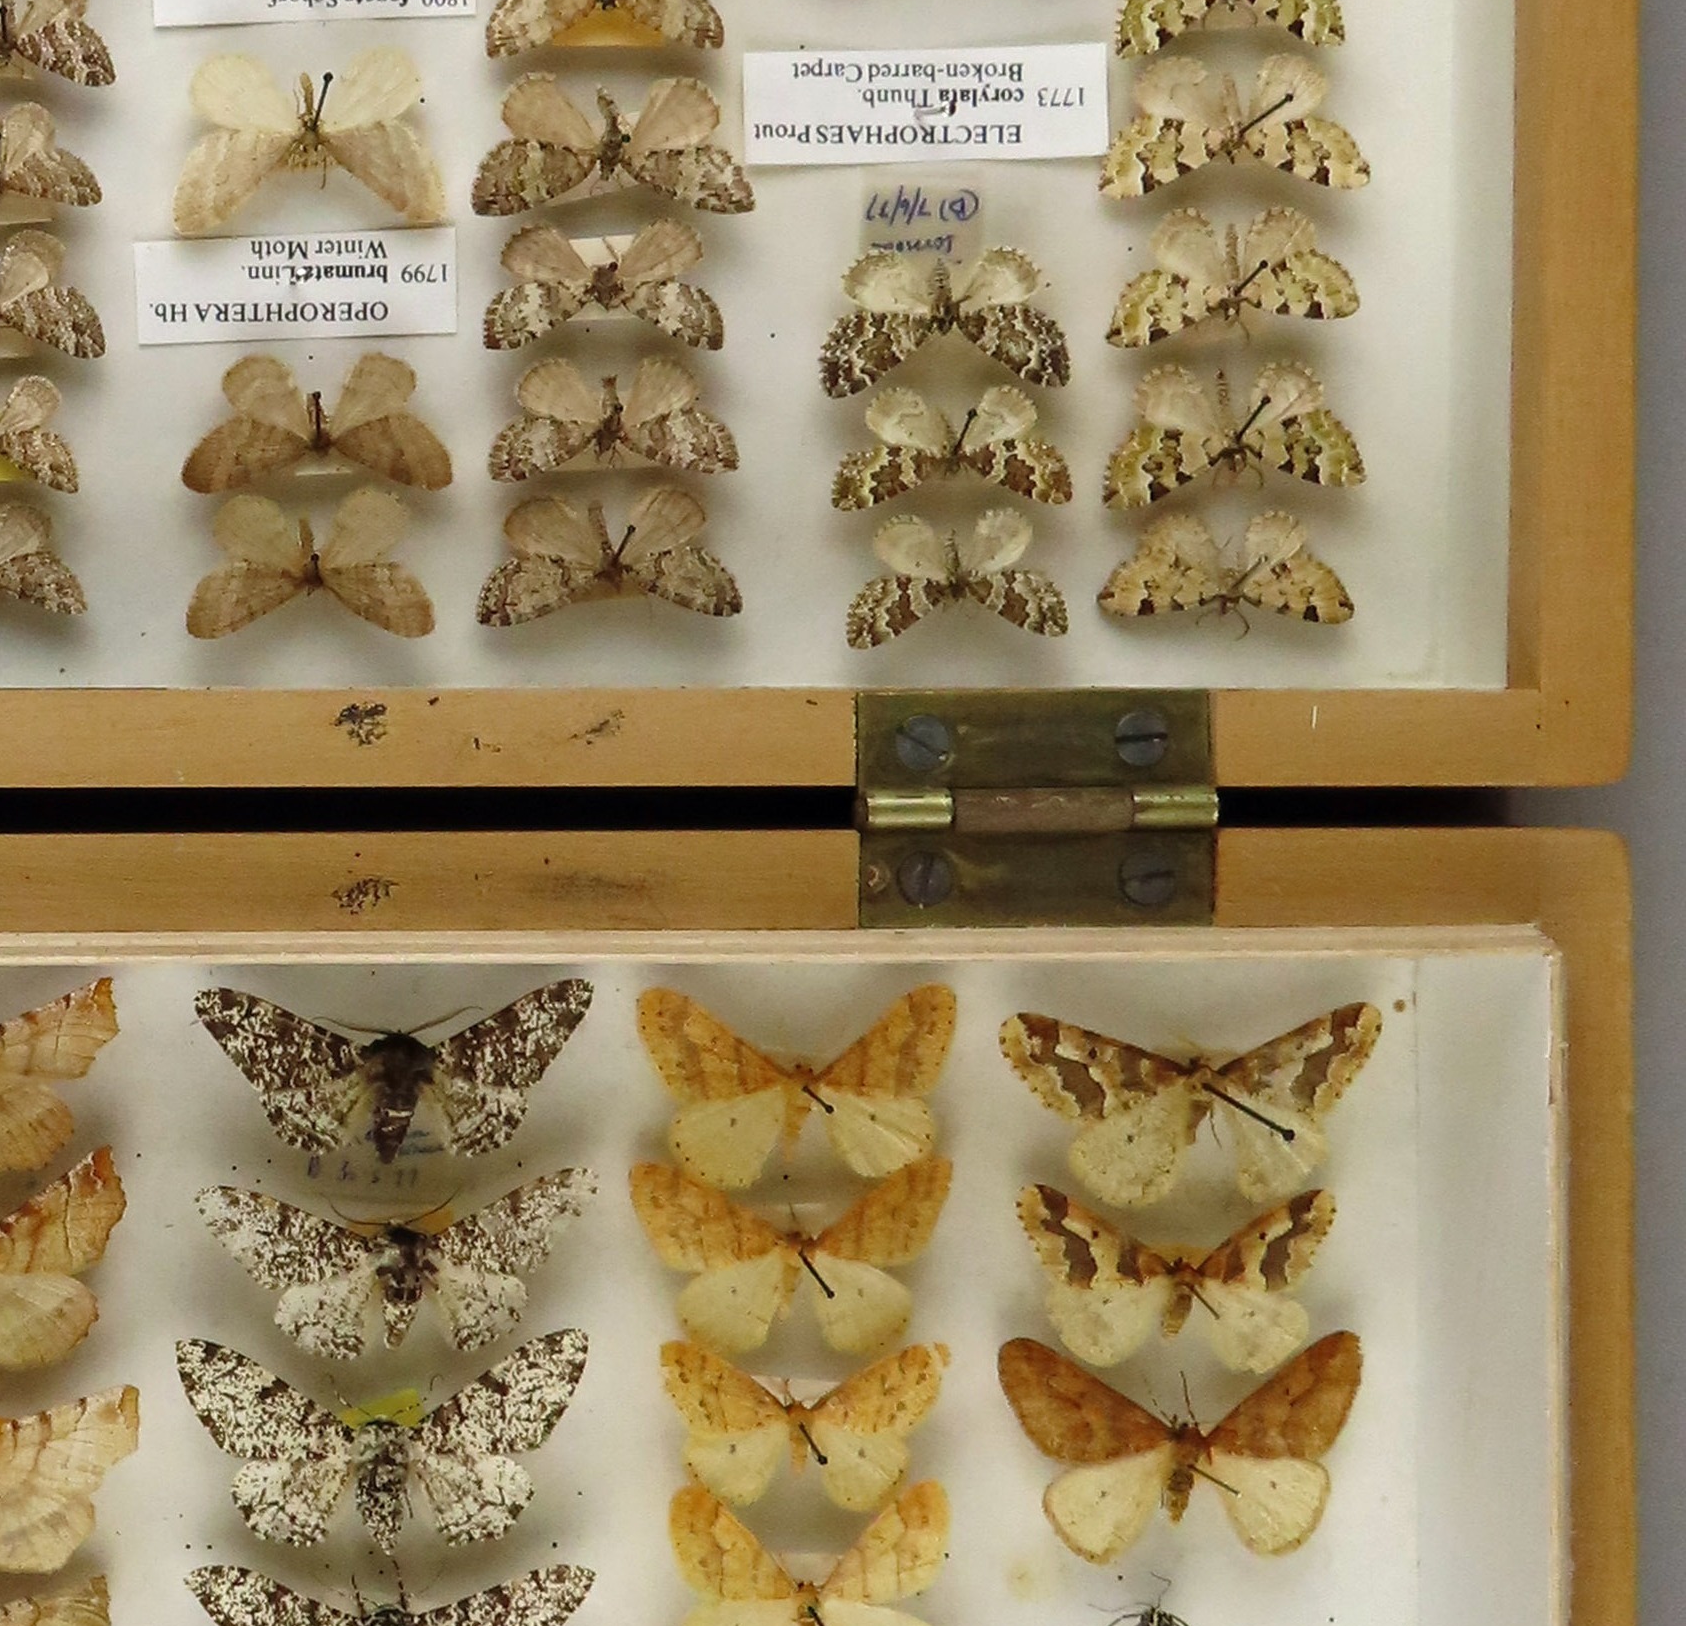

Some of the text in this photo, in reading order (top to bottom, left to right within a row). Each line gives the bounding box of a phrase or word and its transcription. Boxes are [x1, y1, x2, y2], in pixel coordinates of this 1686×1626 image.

[793, 58, 1023, 83] Broken-barred Carpet
[858, 87, 1084, 109] 1773 Thunb.
[755, 124, 1021, 144] ELECTROPHAES Prout
[251, 240, 387, 260] Winter Moth
[242, 264, 446, 286] 1799 Linn.
[150, 301, 388, 322] OPEROPHTERA Hb.
